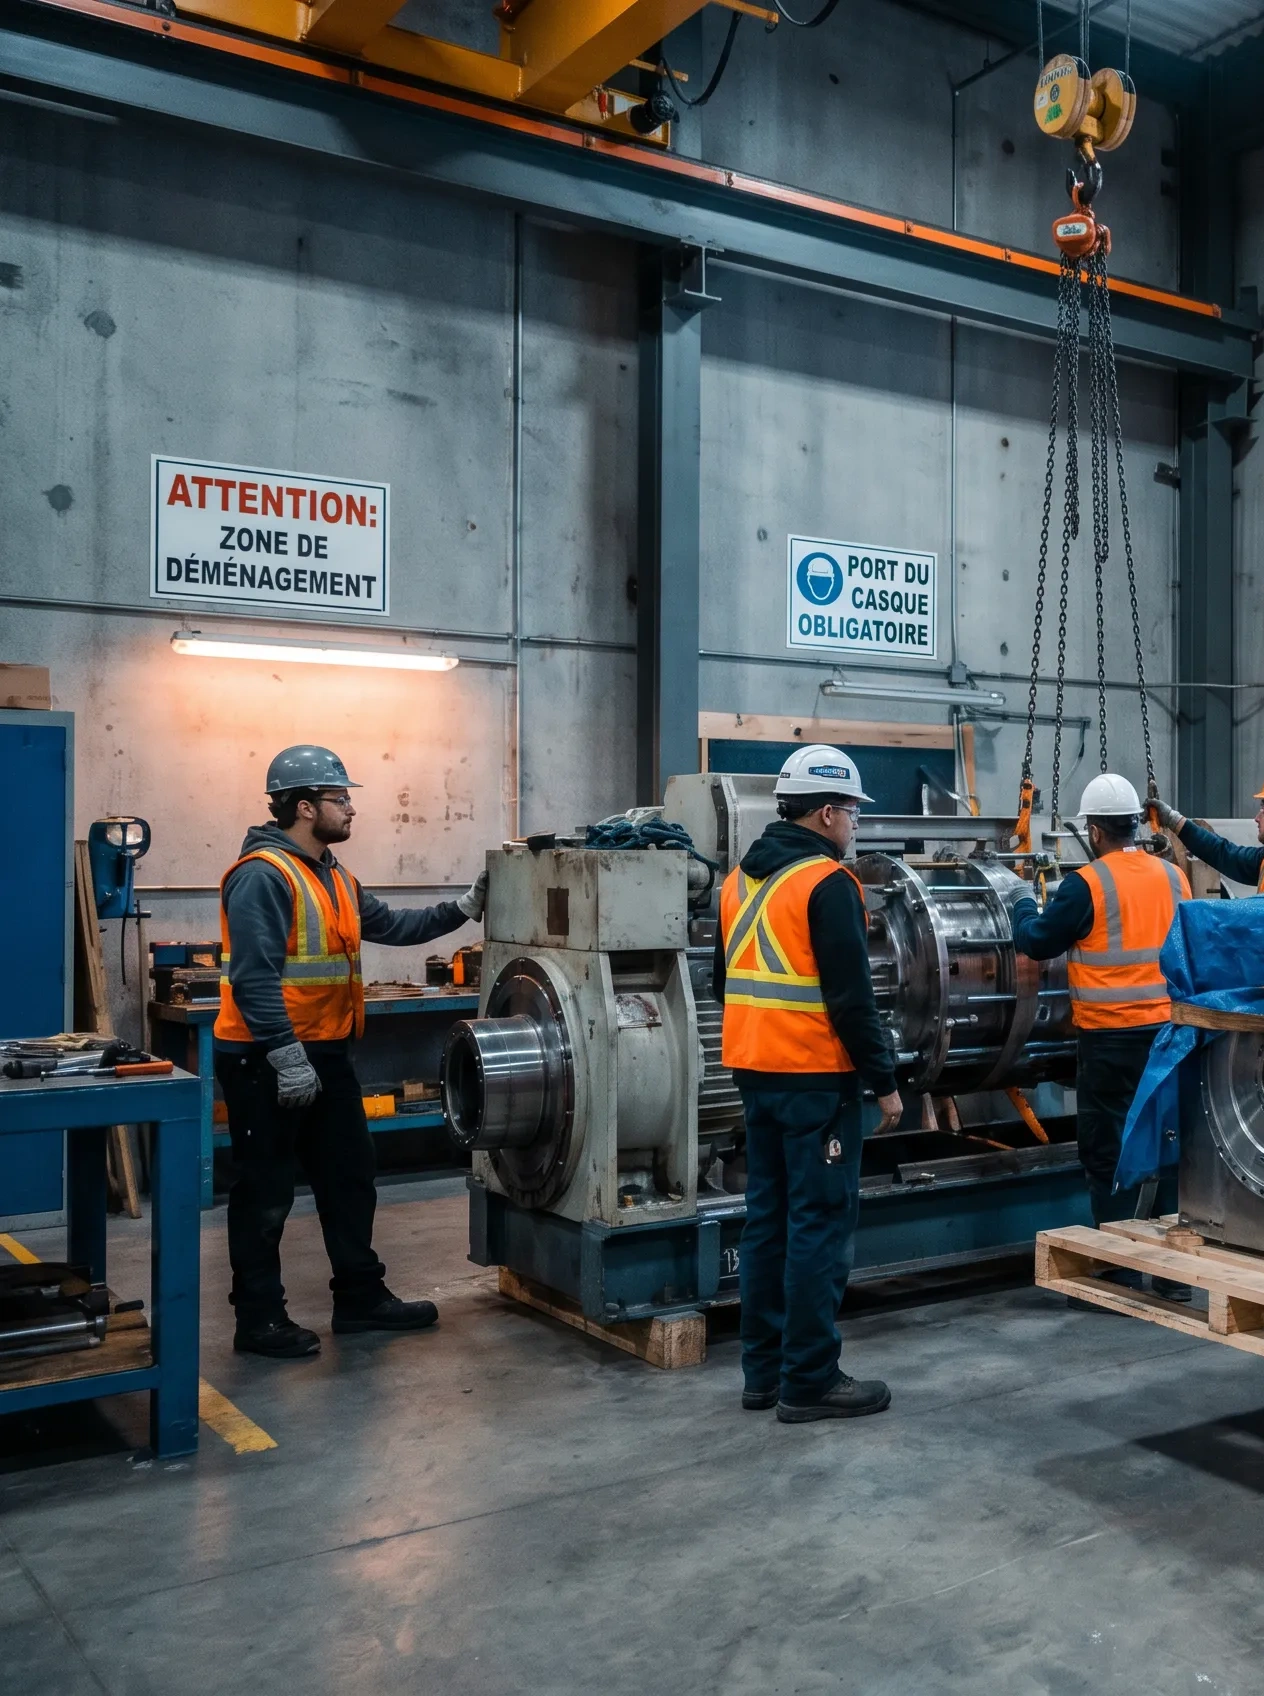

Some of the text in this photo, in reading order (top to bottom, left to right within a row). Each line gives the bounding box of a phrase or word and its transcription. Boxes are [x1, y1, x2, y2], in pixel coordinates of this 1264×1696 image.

[166, 473, 377, 528] ATTENTION:
[219, 525, 329, 560] ZONE DE
[166, 552, 377, 599] DÉMÉNAGEMENT
[847, 554, 930, 586] PORT DU
[851, 586, 929, 616] CASQUE
[797, 612, 929, 647] OBLIGATOIRE
